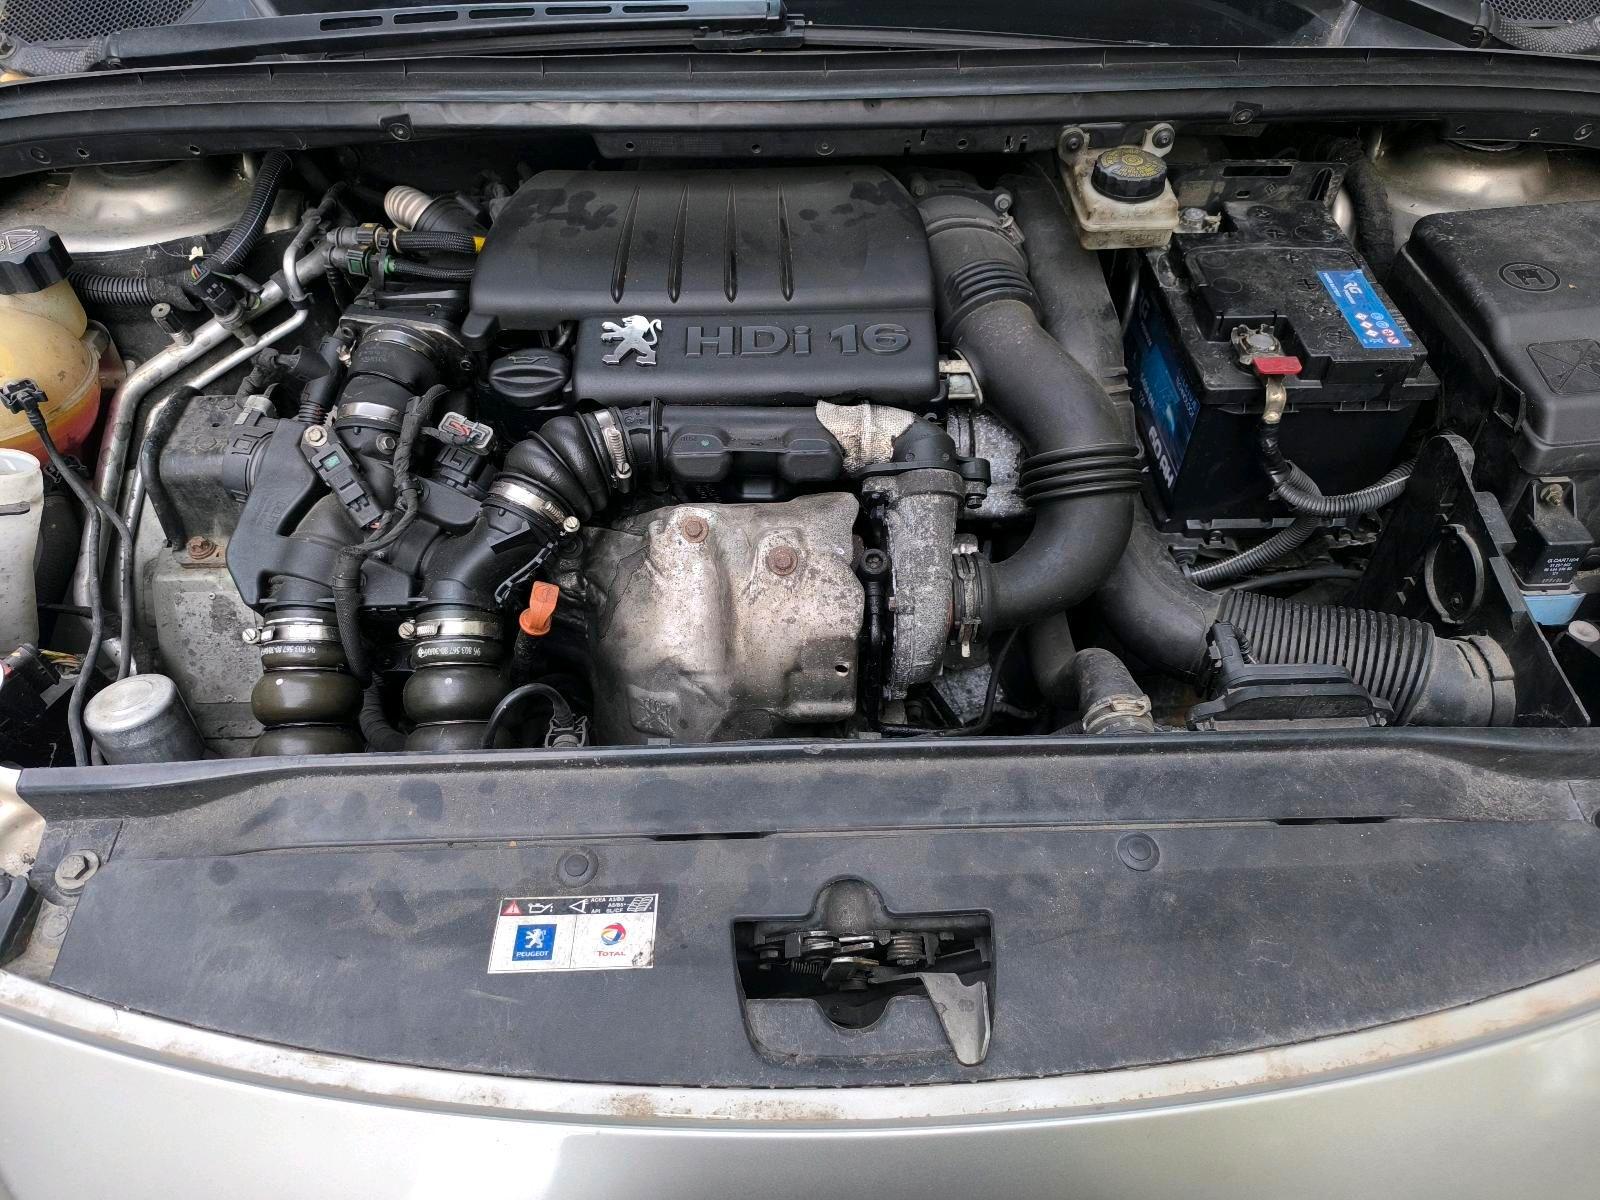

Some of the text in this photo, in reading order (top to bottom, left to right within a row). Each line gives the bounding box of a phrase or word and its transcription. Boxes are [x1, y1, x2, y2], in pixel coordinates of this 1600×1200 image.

[685, 323, 911, 357] HDi 16
[449, 646, 461, 655] 567
[473, 647, 481, 656] 96
[516, 950, 550, 958] PEUGEOT
